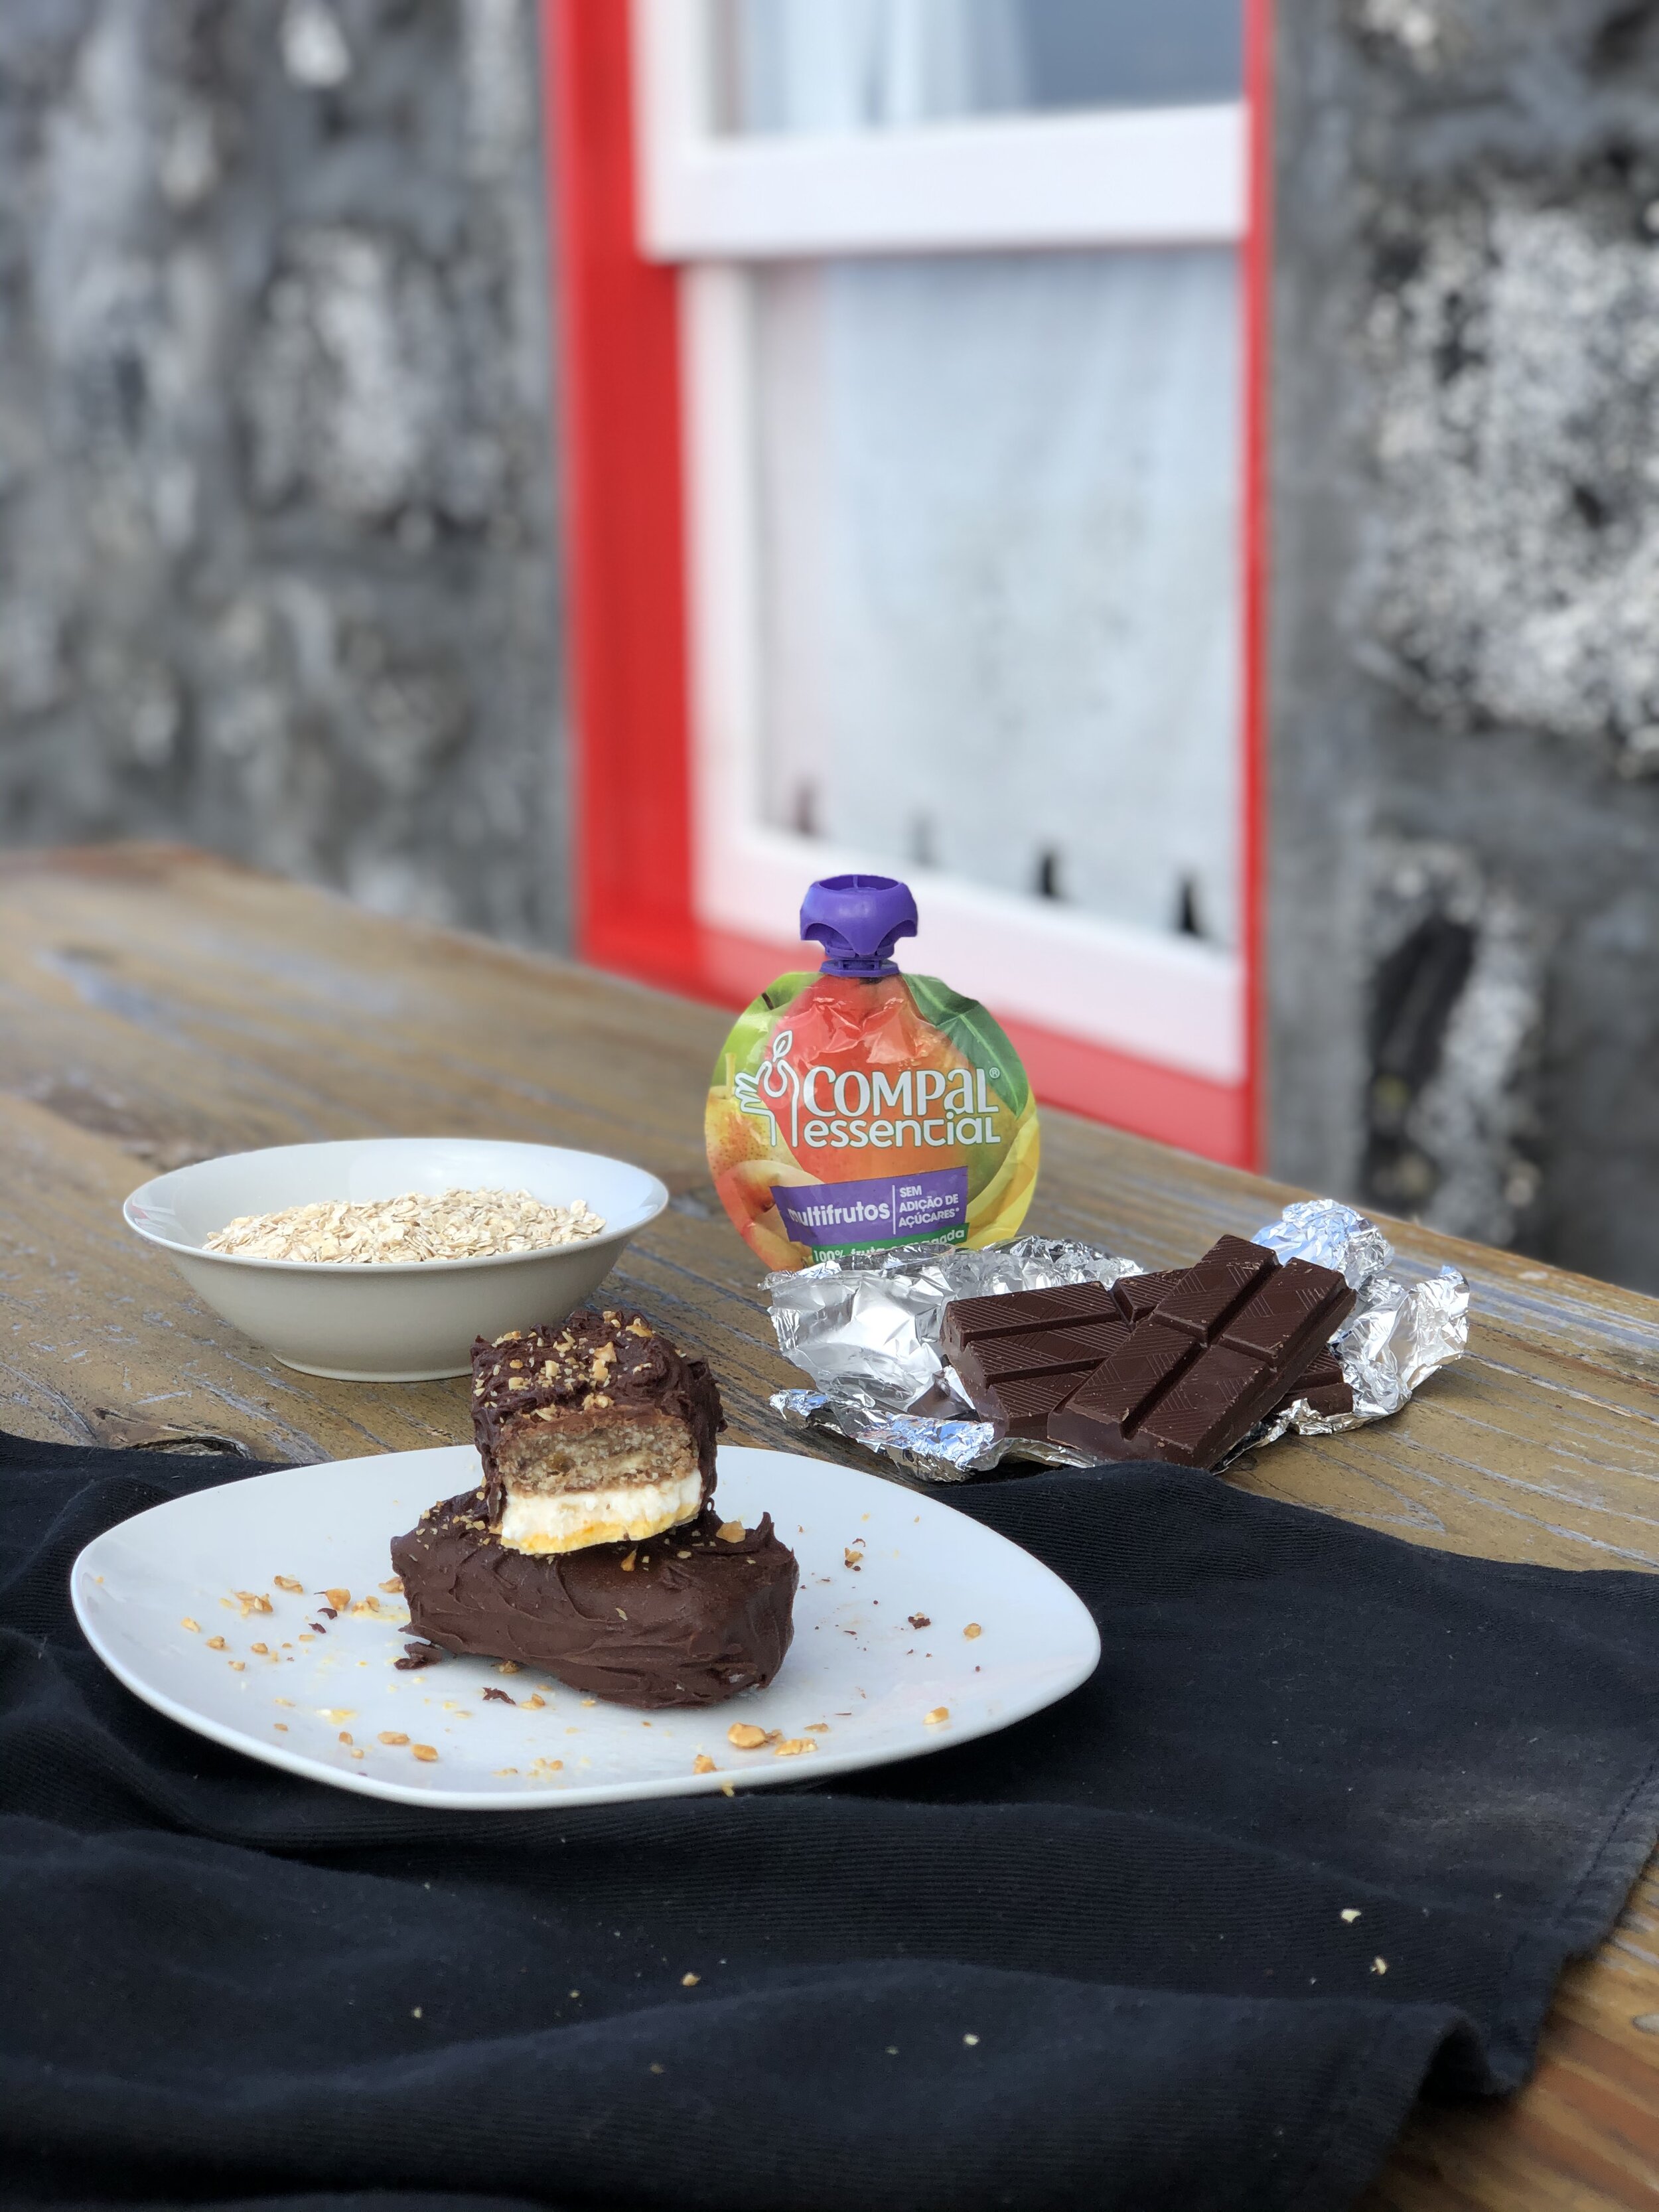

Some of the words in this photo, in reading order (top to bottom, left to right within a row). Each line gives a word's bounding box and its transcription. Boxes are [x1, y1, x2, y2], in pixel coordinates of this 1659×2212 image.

[899, 1185, 922, 1198] SEM
[899, 1196, 943, 1213] ADIÇÃO
[945, 1193, 959, 1205] DE
